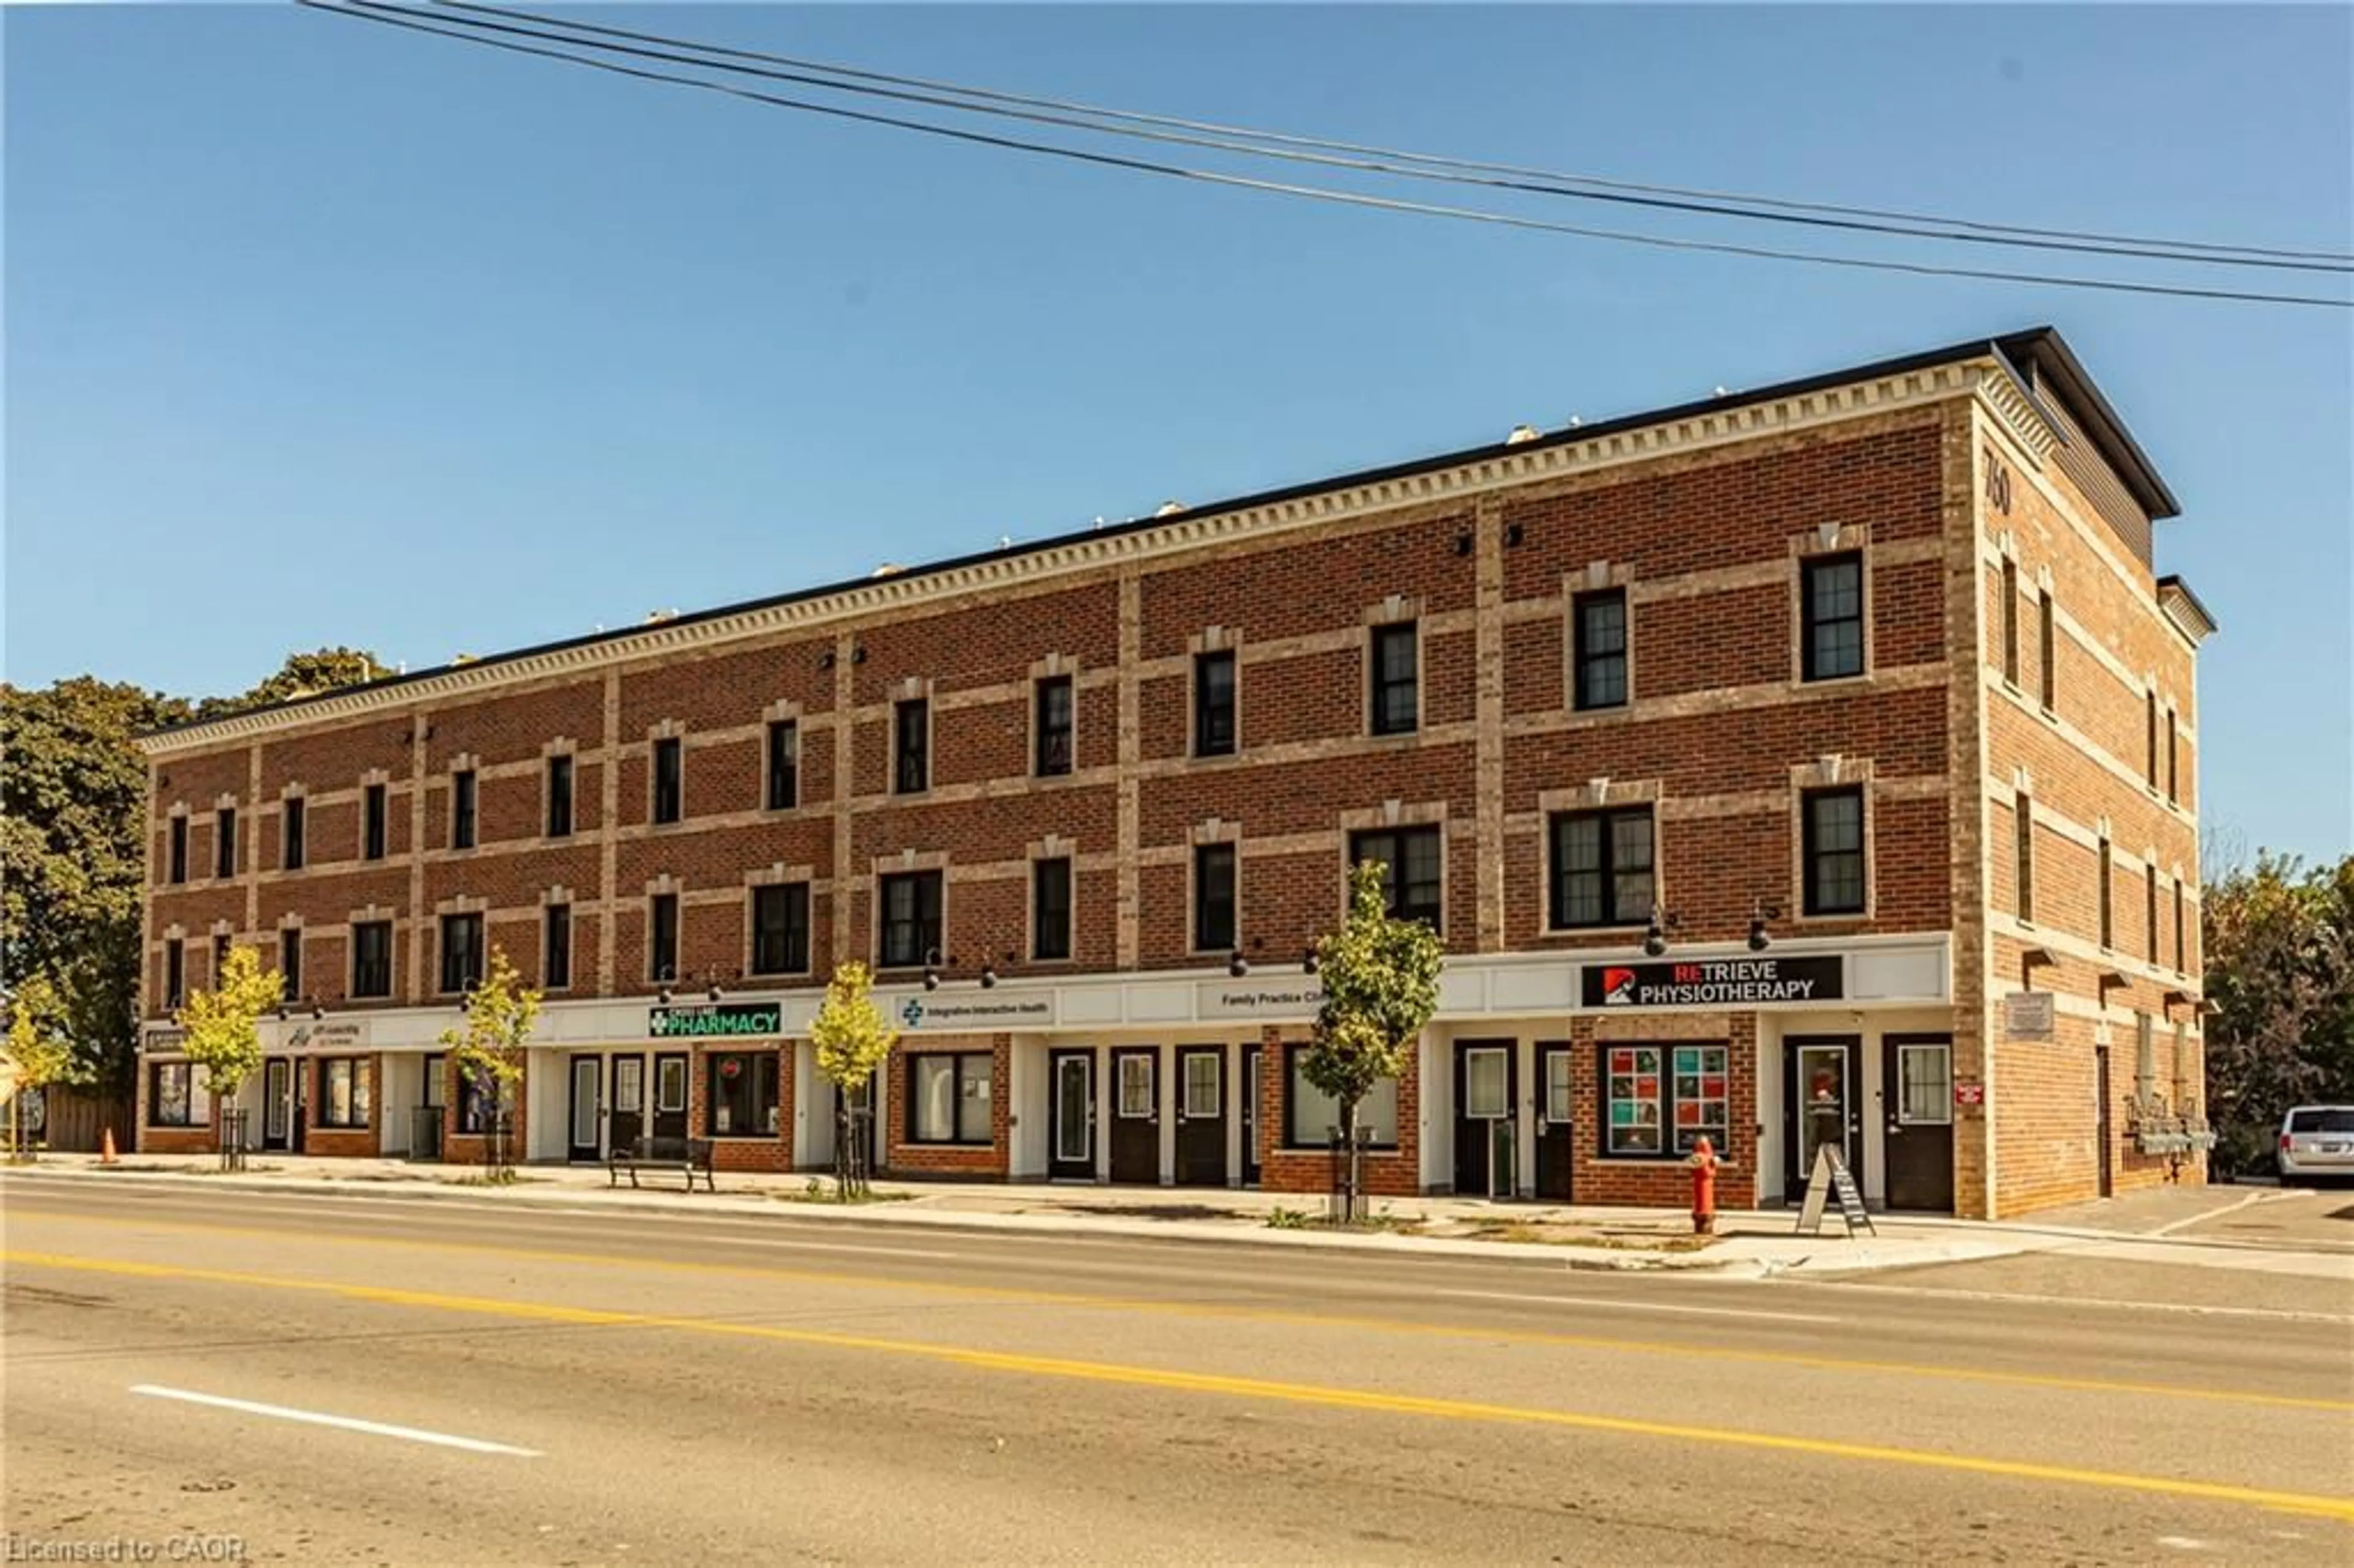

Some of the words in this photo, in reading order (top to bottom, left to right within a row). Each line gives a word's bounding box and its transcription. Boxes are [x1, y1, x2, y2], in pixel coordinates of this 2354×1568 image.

[1675, 961, 1778, 983] RETRIEVE
[1222, 993, 1255, 1007] Family
[1259, 992, 1301, 1003] Practice
[1639, 980, 1815, 1004] PHYSIOTHERAPY
[1019, 1002, 1048, 1012] Health
[668, 1012, 778, 1034] PHARMACY
